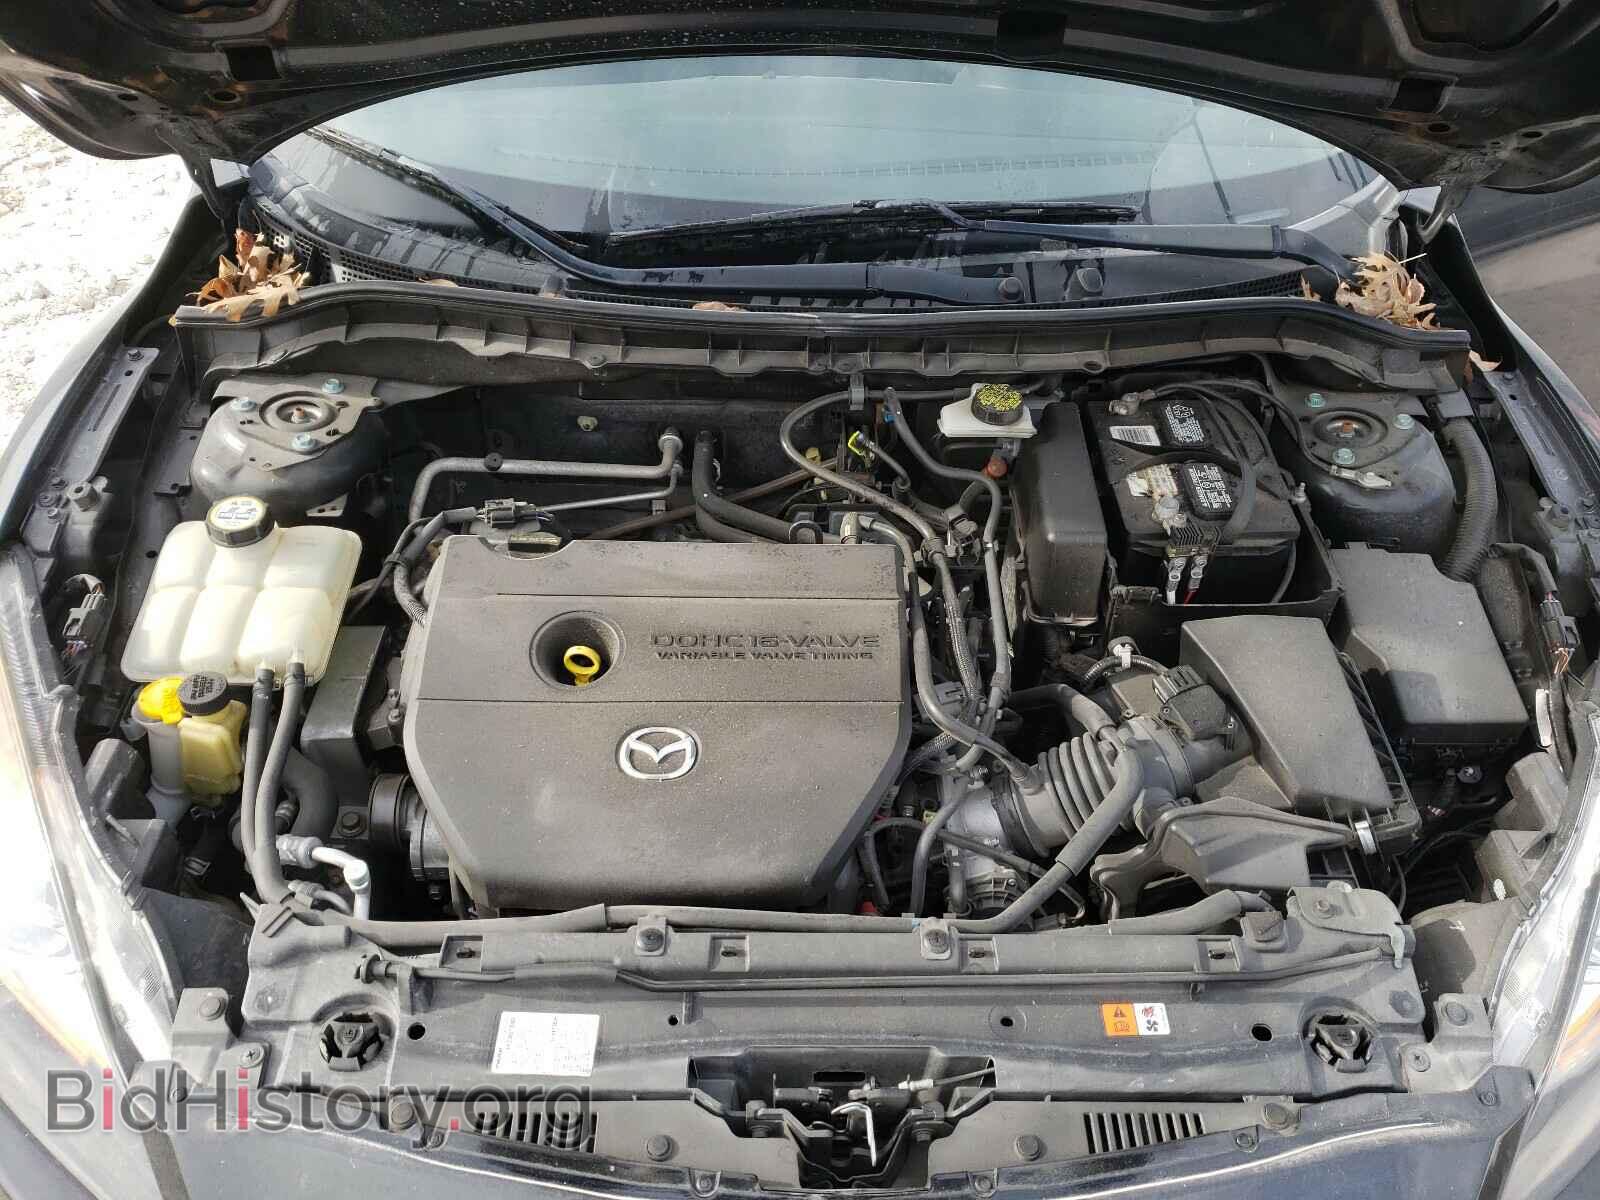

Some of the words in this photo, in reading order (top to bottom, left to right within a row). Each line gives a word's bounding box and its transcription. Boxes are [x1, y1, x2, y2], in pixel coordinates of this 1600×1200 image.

[653, 633, 745, 648] DOHC
[750, 633, 881, 648] 16-VALVE
[656, 650, 746, 660] VARIABLE
[751, 650, 807, 660] VALVE
[812, 650, 874, 660] TIMING
